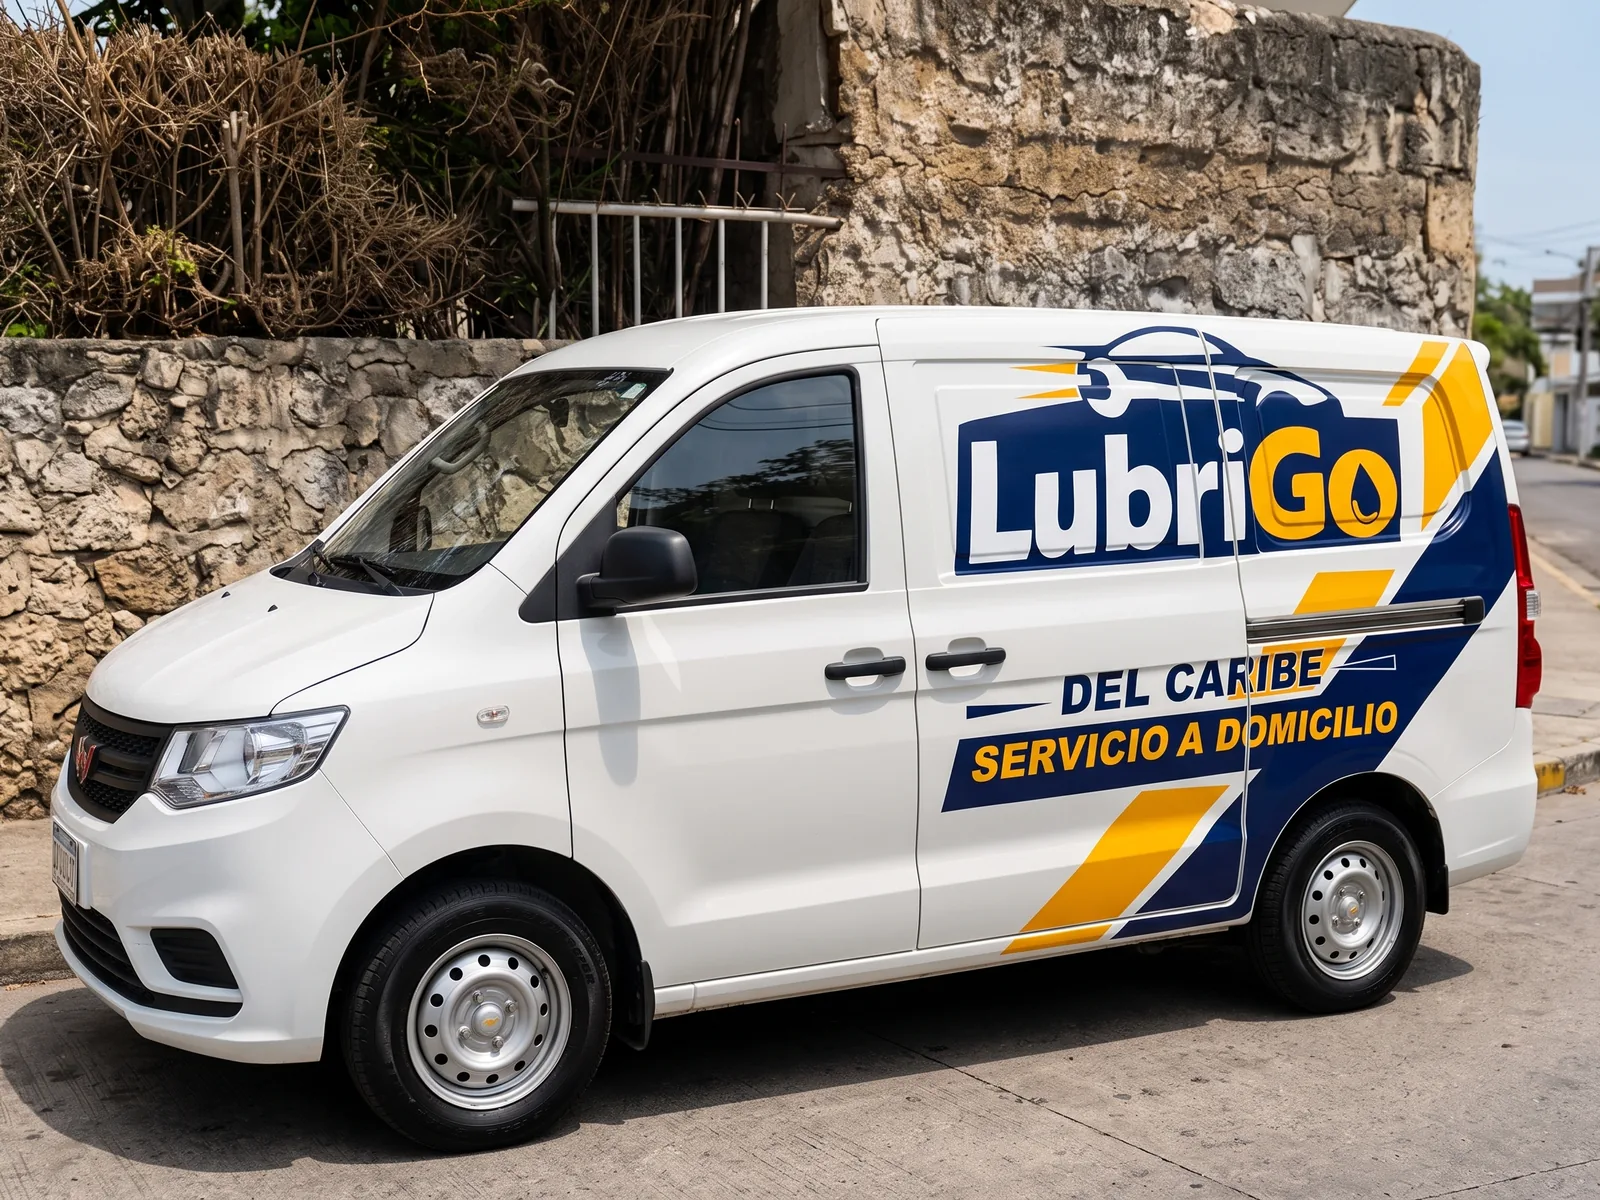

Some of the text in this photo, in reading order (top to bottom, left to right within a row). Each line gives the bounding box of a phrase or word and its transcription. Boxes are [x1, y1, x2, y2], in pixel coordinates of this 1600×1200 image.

[970, 427, 1398, 564] LubriGo
[1061, 650, 1323, 716] DEL CARIBE
[971, 701, 1398, 783] SERVICIO A DOMICILIO
